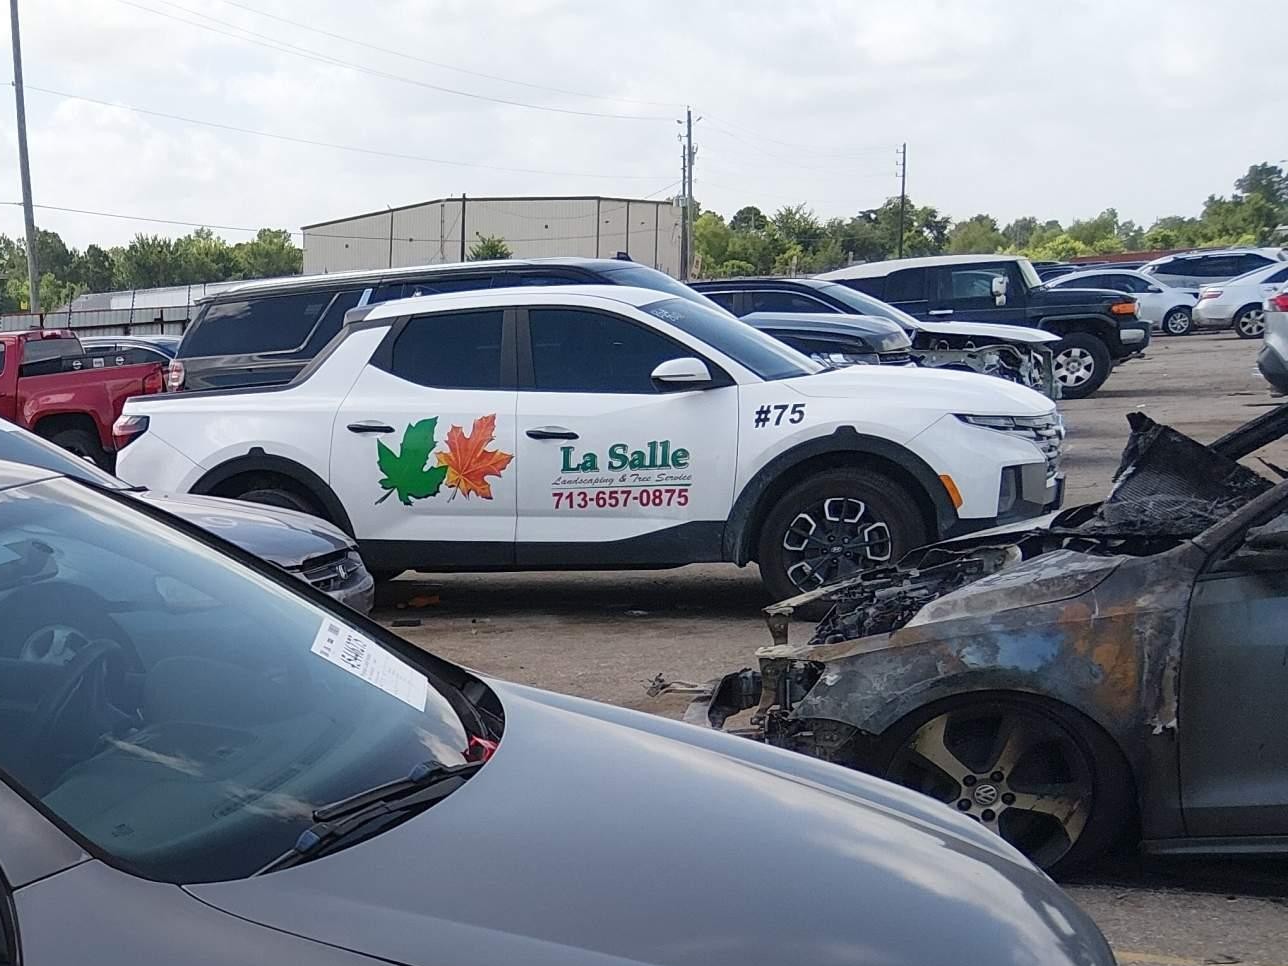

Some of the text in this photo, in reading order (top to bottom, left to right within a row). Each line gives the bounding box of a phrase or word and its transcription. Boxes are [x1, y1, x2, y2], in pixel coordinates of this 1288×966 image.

[754, 403, 806, 429] #75
[560, 440, 691, 473] La Salle
[552, 473, 692, 486] Landscaping & Tree Service
[552, 488, 689, 509] 713-657-0875
